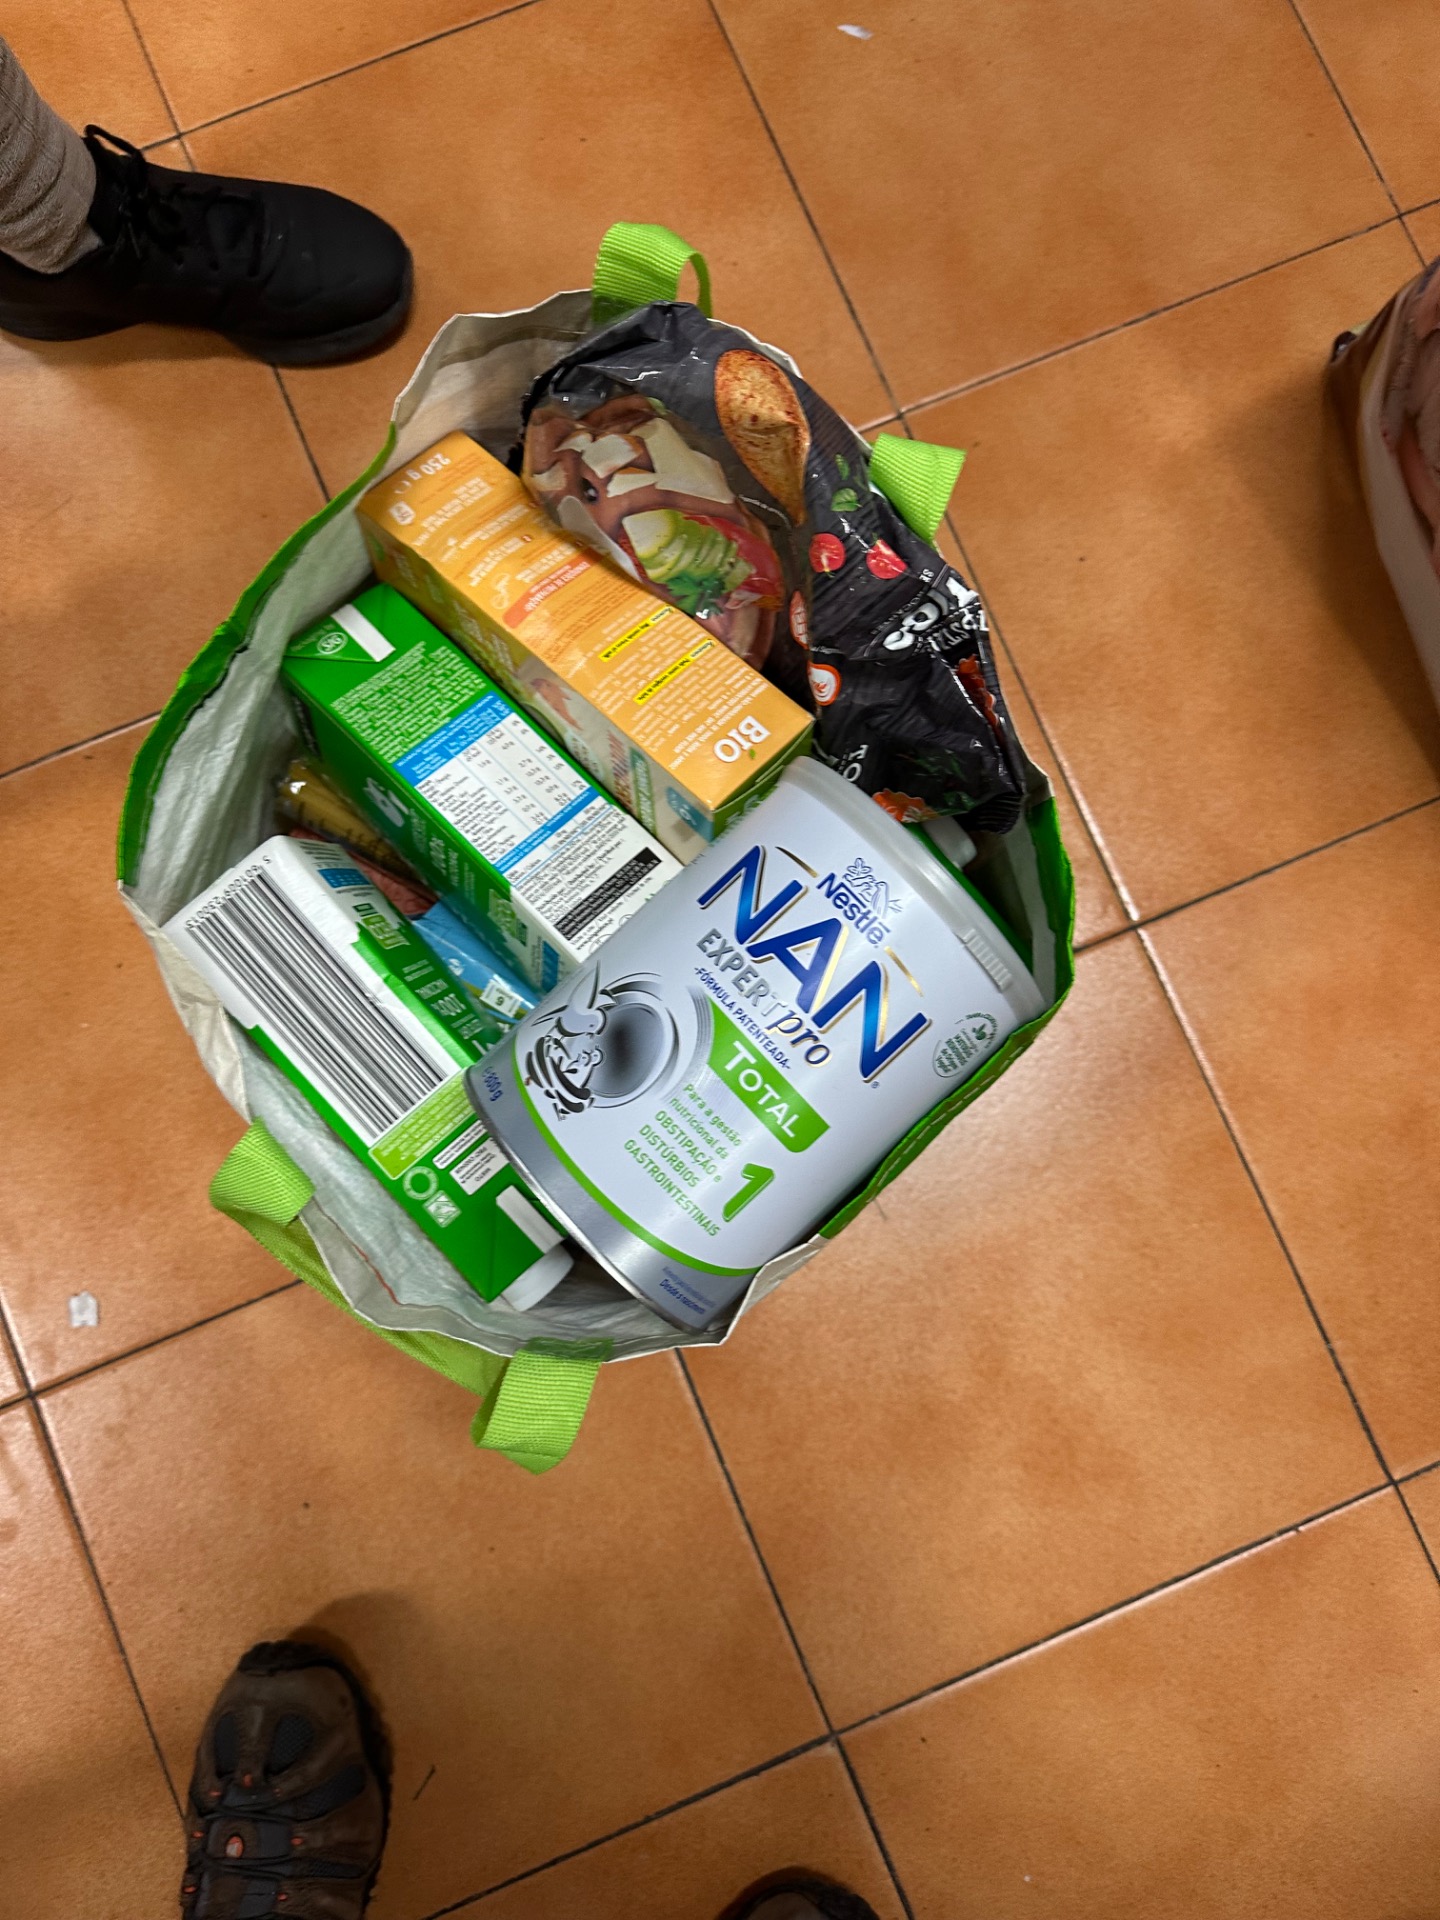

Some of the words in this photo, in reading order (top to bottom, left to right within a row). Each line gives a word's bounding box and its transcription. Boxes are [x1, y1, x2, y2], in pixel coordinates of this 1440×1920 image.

[418, 451, 451, 478] 250
[714, 714, 771, 764] BIO
[814, 871, 892, 949] Nestlé
[694, 842, 933, 1086] NAN
[683, 1083, 707, 1110] Para
[708, 1116, 742, 1148] gestão
[723, 1039, 797, 1139] TOTAL
[638, 1123, 702, 1189] DISTÚRBIOS
[654, 1109, 718, 1177] OBSTIPAÇÃO
[668, 1096, 720, 1149] nutricional
[715, 1144, 730, 1161] da
[622, 1137, 721, 1238] GASTROINTESTINAIS
[720, 1169, 777, 1223] 1
